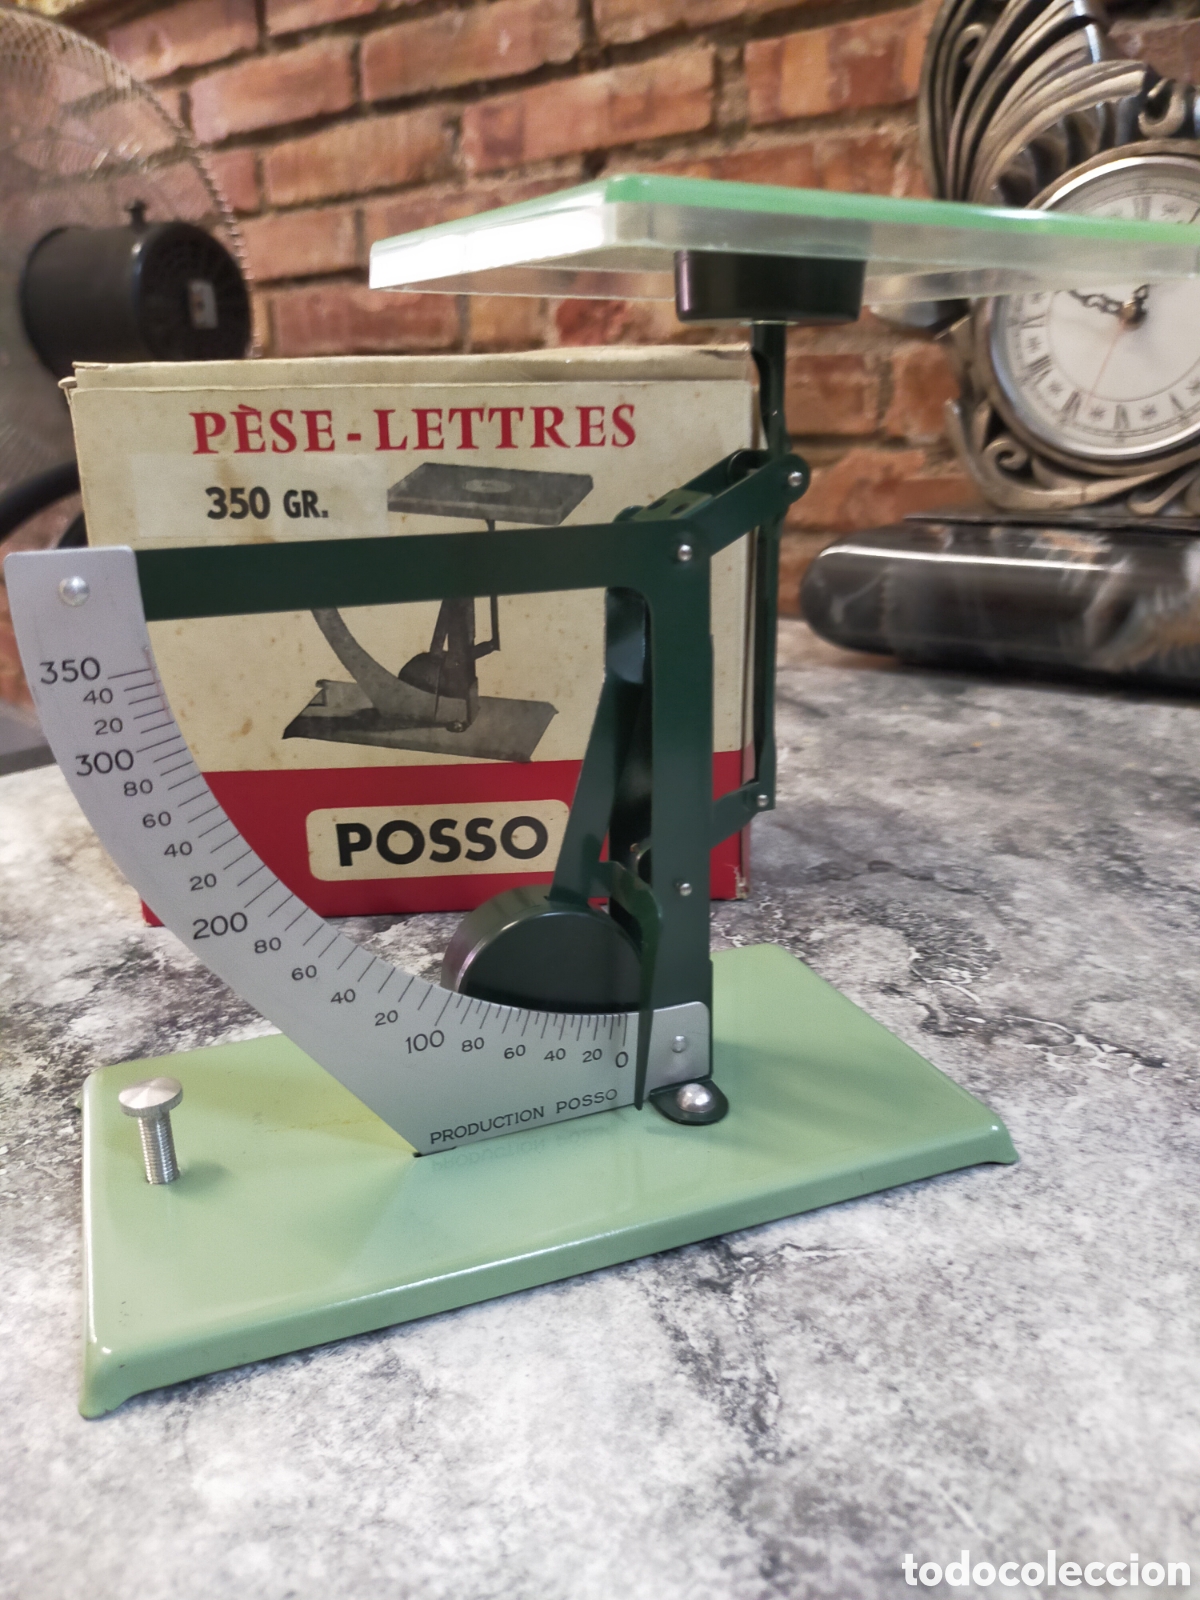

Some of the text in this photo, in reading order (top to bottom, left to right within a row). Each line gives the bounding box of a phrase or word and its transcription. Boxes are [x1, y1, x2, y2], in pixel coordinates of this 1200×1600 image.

[205, 486, 329, 520] 350 GR.
[39, 656, 101, 685] 350
[82, 687, 114, 705] 40
[94, 717, 124, 736] 20
[75, 748, 134, 777] 300
[123, 778, 154, 797] 80
[142, 811, 172, 829] 60
[163, 841, 193, 858] 40
[335, 815, 549, 867] POSSO
[189, 873, 217, 892] 20
[192, 911, 248, 941] 200
[254, 936, 282, 954] 80
[291, 964, 317, 981] 60
[330, 988, 356, 1005] 40
[374, 1009, 399, 1027] 20
[405, 1029, 445, 1054] 100
[461, 1036, 485, 1053] 80
[503, 1044, 526, 1060] 60
[543, 1047, 566, 1062] 40
[582, 1048, 603, 1063] 20
[614, 1051, 629, 1069] 0
[429, 1088, 618, 1145] PRODUCTION POSSO
